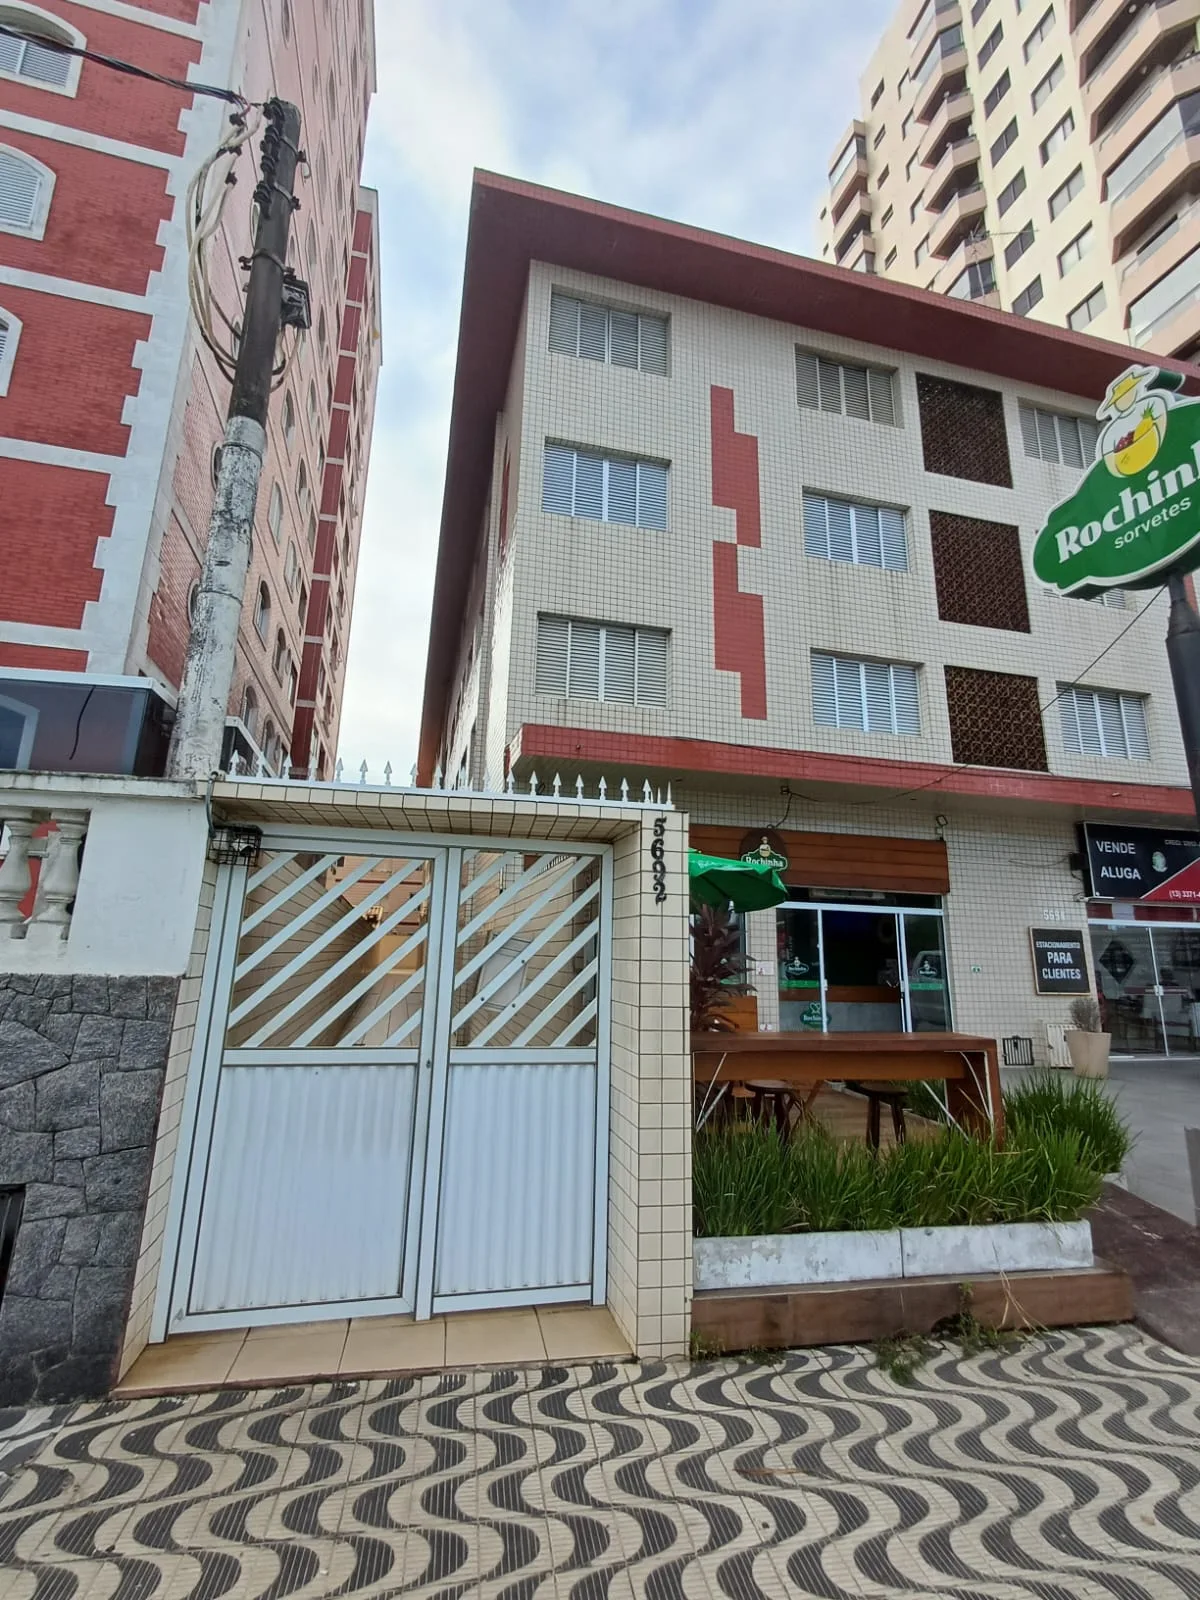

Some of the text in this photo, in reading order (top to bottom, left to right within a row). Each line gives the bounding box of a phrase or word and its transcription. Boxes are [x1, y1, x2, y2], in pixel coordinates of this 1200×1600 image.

[1114, 497, 1192, 549] sorvetes
[1096, 841, 1136, 854] VENDE
[651, 816, 667, 906] 5692
[1101, 866, 1141, 880] ALUGA
[1182, 890, 1200, 898] 3371-
[1047, 952, 1073, 964] PARA
[1042, 968, 1082, 979] CLIENTES
